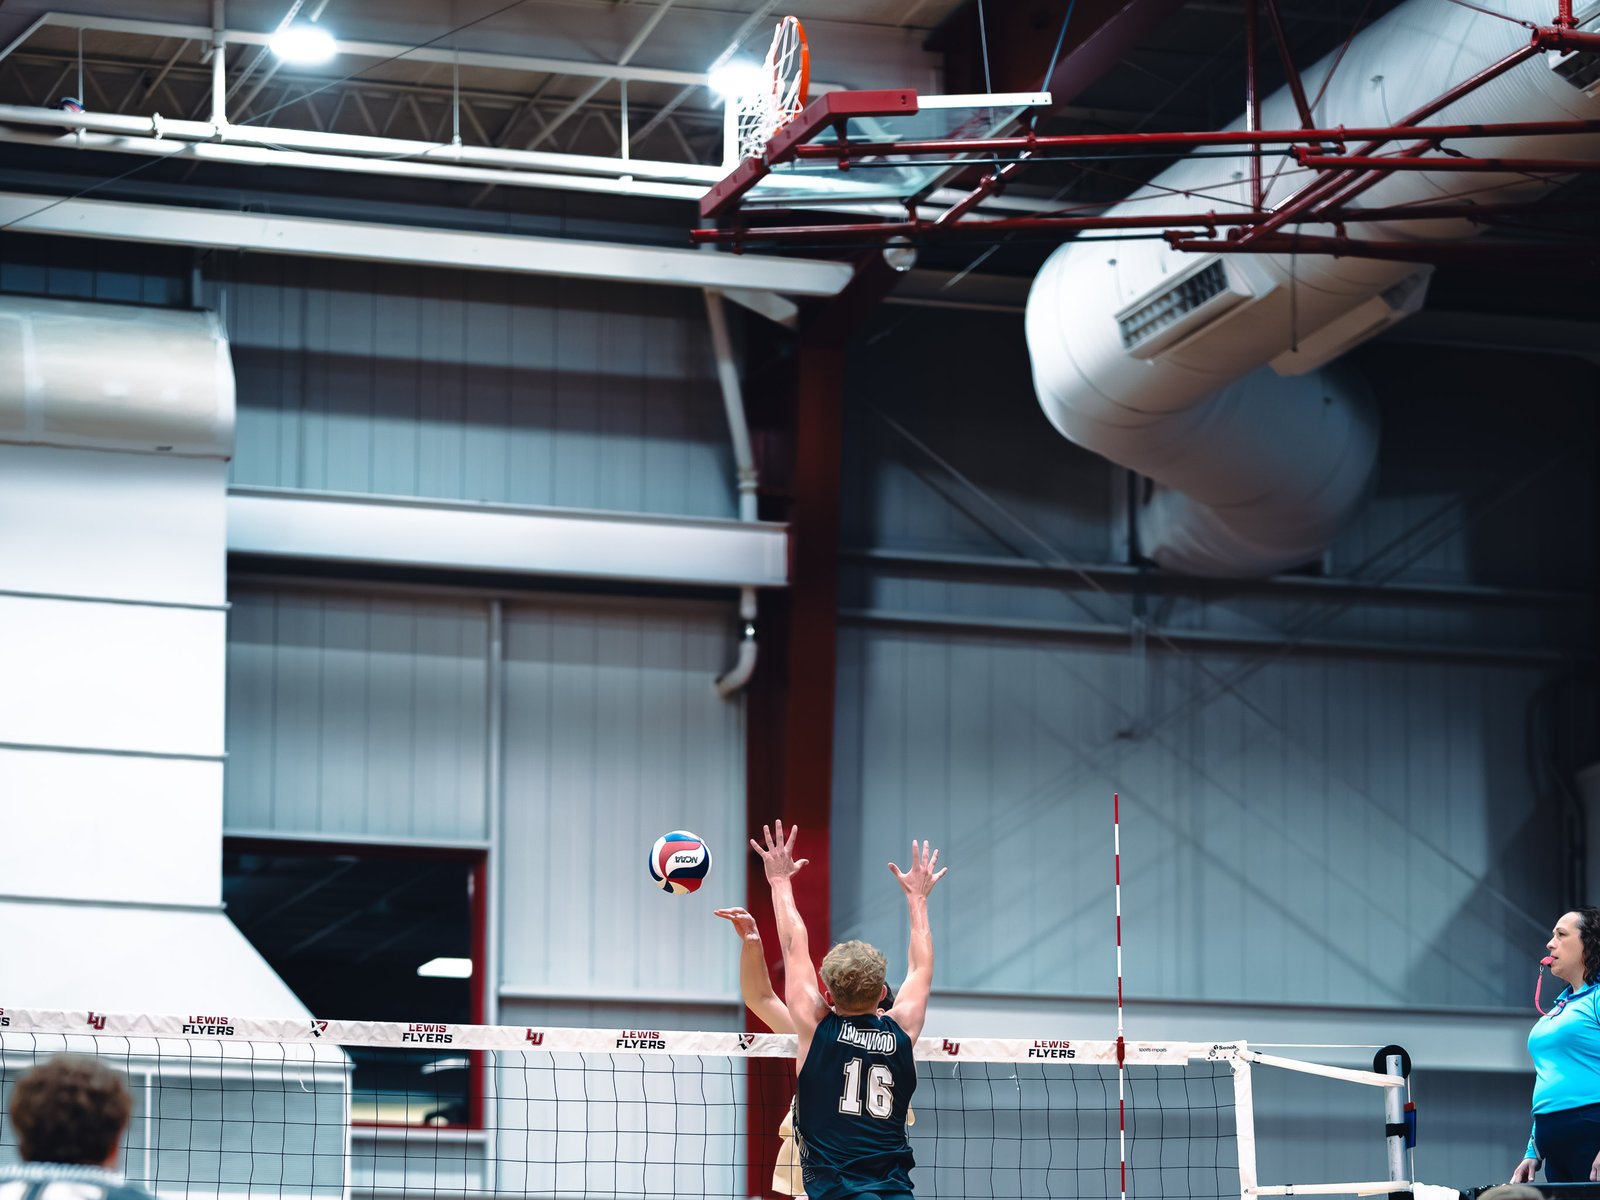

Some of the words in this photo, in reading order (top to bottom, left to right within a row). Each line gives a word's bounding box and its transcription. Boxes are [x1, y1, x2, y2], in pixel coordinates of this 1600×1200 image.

[674, 856, 698, 864] NCAA
[87, 1012, 107, 1030] LU
[189, 1016, 229, 1025] LEWIS
[182, 1025, 235, 1036] FLYERS
[408, 1024, 447, 1033] LEWIS
[402, 1033, 453, 1043] FLYERS
[526, 1029, 544, 1046] LU
[622, 1031, 660, 1039] LEWIS
[616, 1040, 666, 1050] FLYERS
[942, 1039, 960, 1056] LU
[1034, 1040, 1070, 1049] LEWIS
[1028, 1049, 1076, 1059] FLYERS
[838, 1057, 895, 1120] 16
